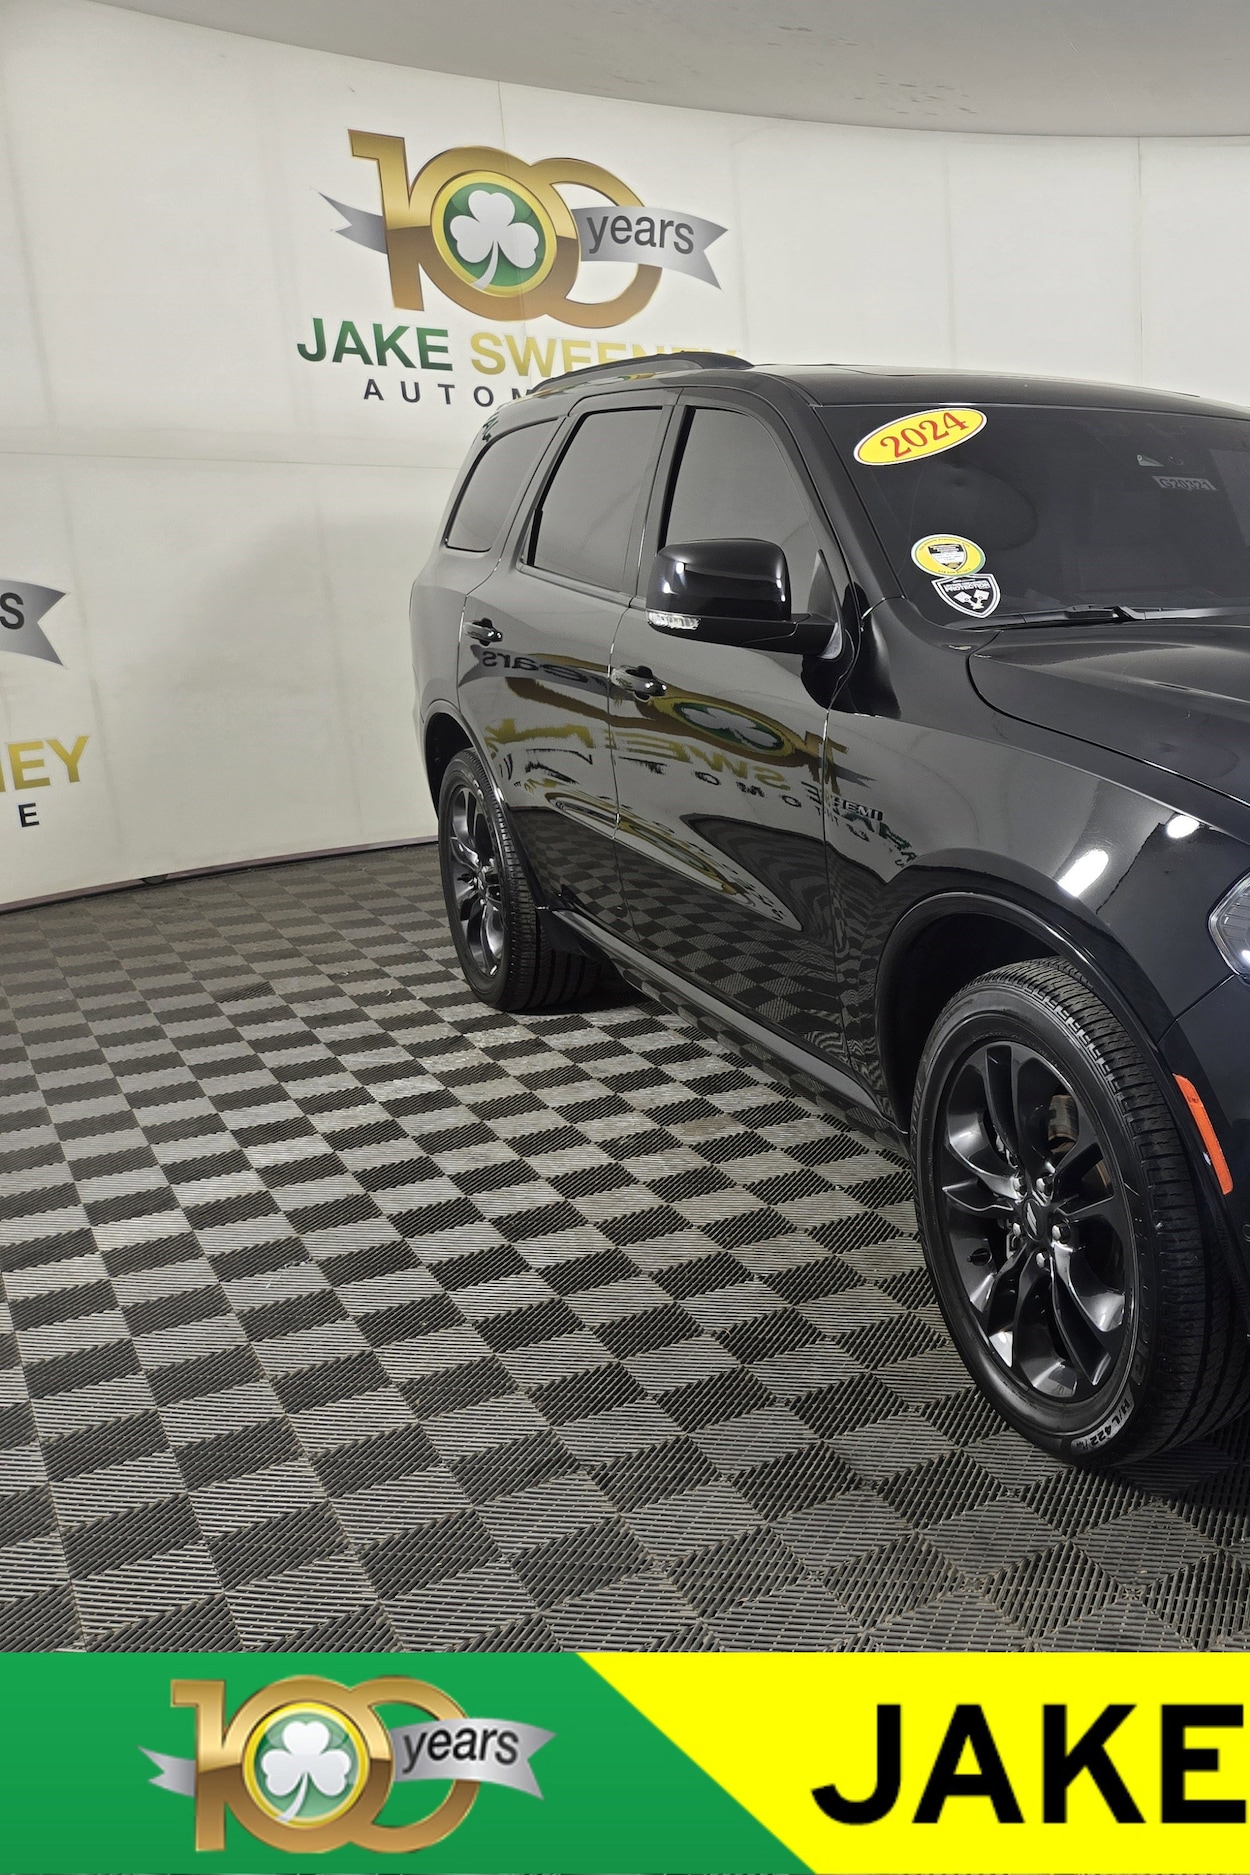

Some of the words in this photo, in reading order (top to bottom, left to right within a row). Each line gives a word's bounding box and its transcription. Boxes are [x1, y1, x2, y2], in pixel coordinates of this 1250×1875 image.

[347, 129, 663, 329] 100
[586, 213, 695, 255] years
[297, 317, 453, 371] JAKE
[880, 412, 968, 458] 2024
[1089, 1424, 1112, 1446] 422
